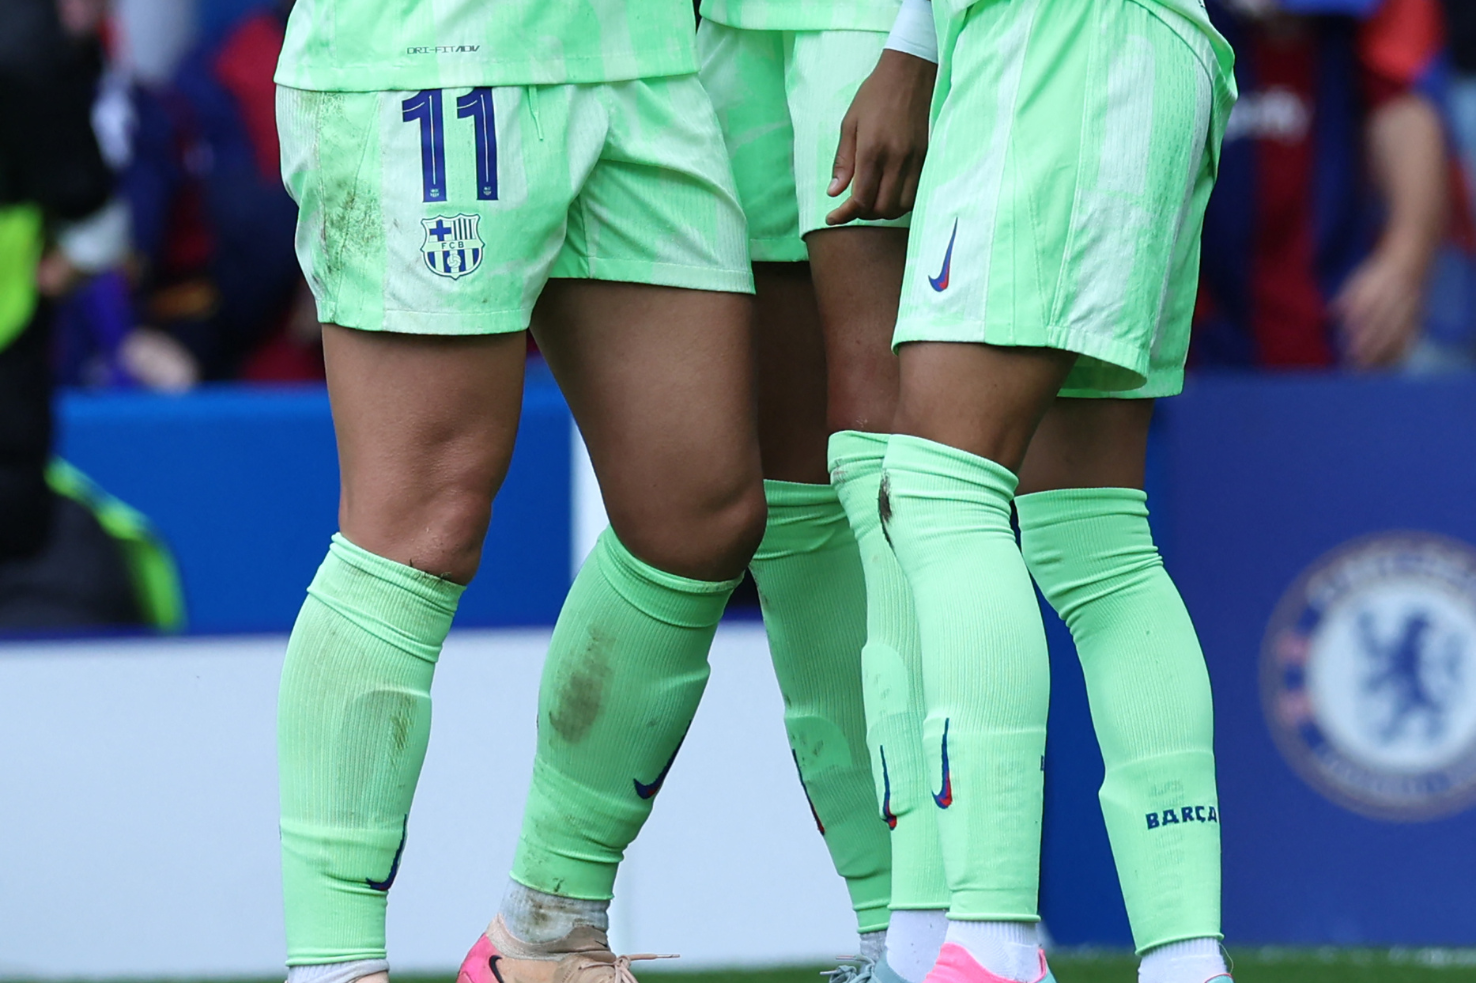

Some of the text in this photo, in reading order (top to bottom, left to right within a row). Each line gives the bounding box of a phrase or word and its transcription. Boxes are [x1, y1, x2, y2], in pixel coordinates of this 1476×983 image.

[401, 87, 498, 204] 11
[440, 240, 465, 250] FCB
[1145, 804, 1218, 830] BARÇA
